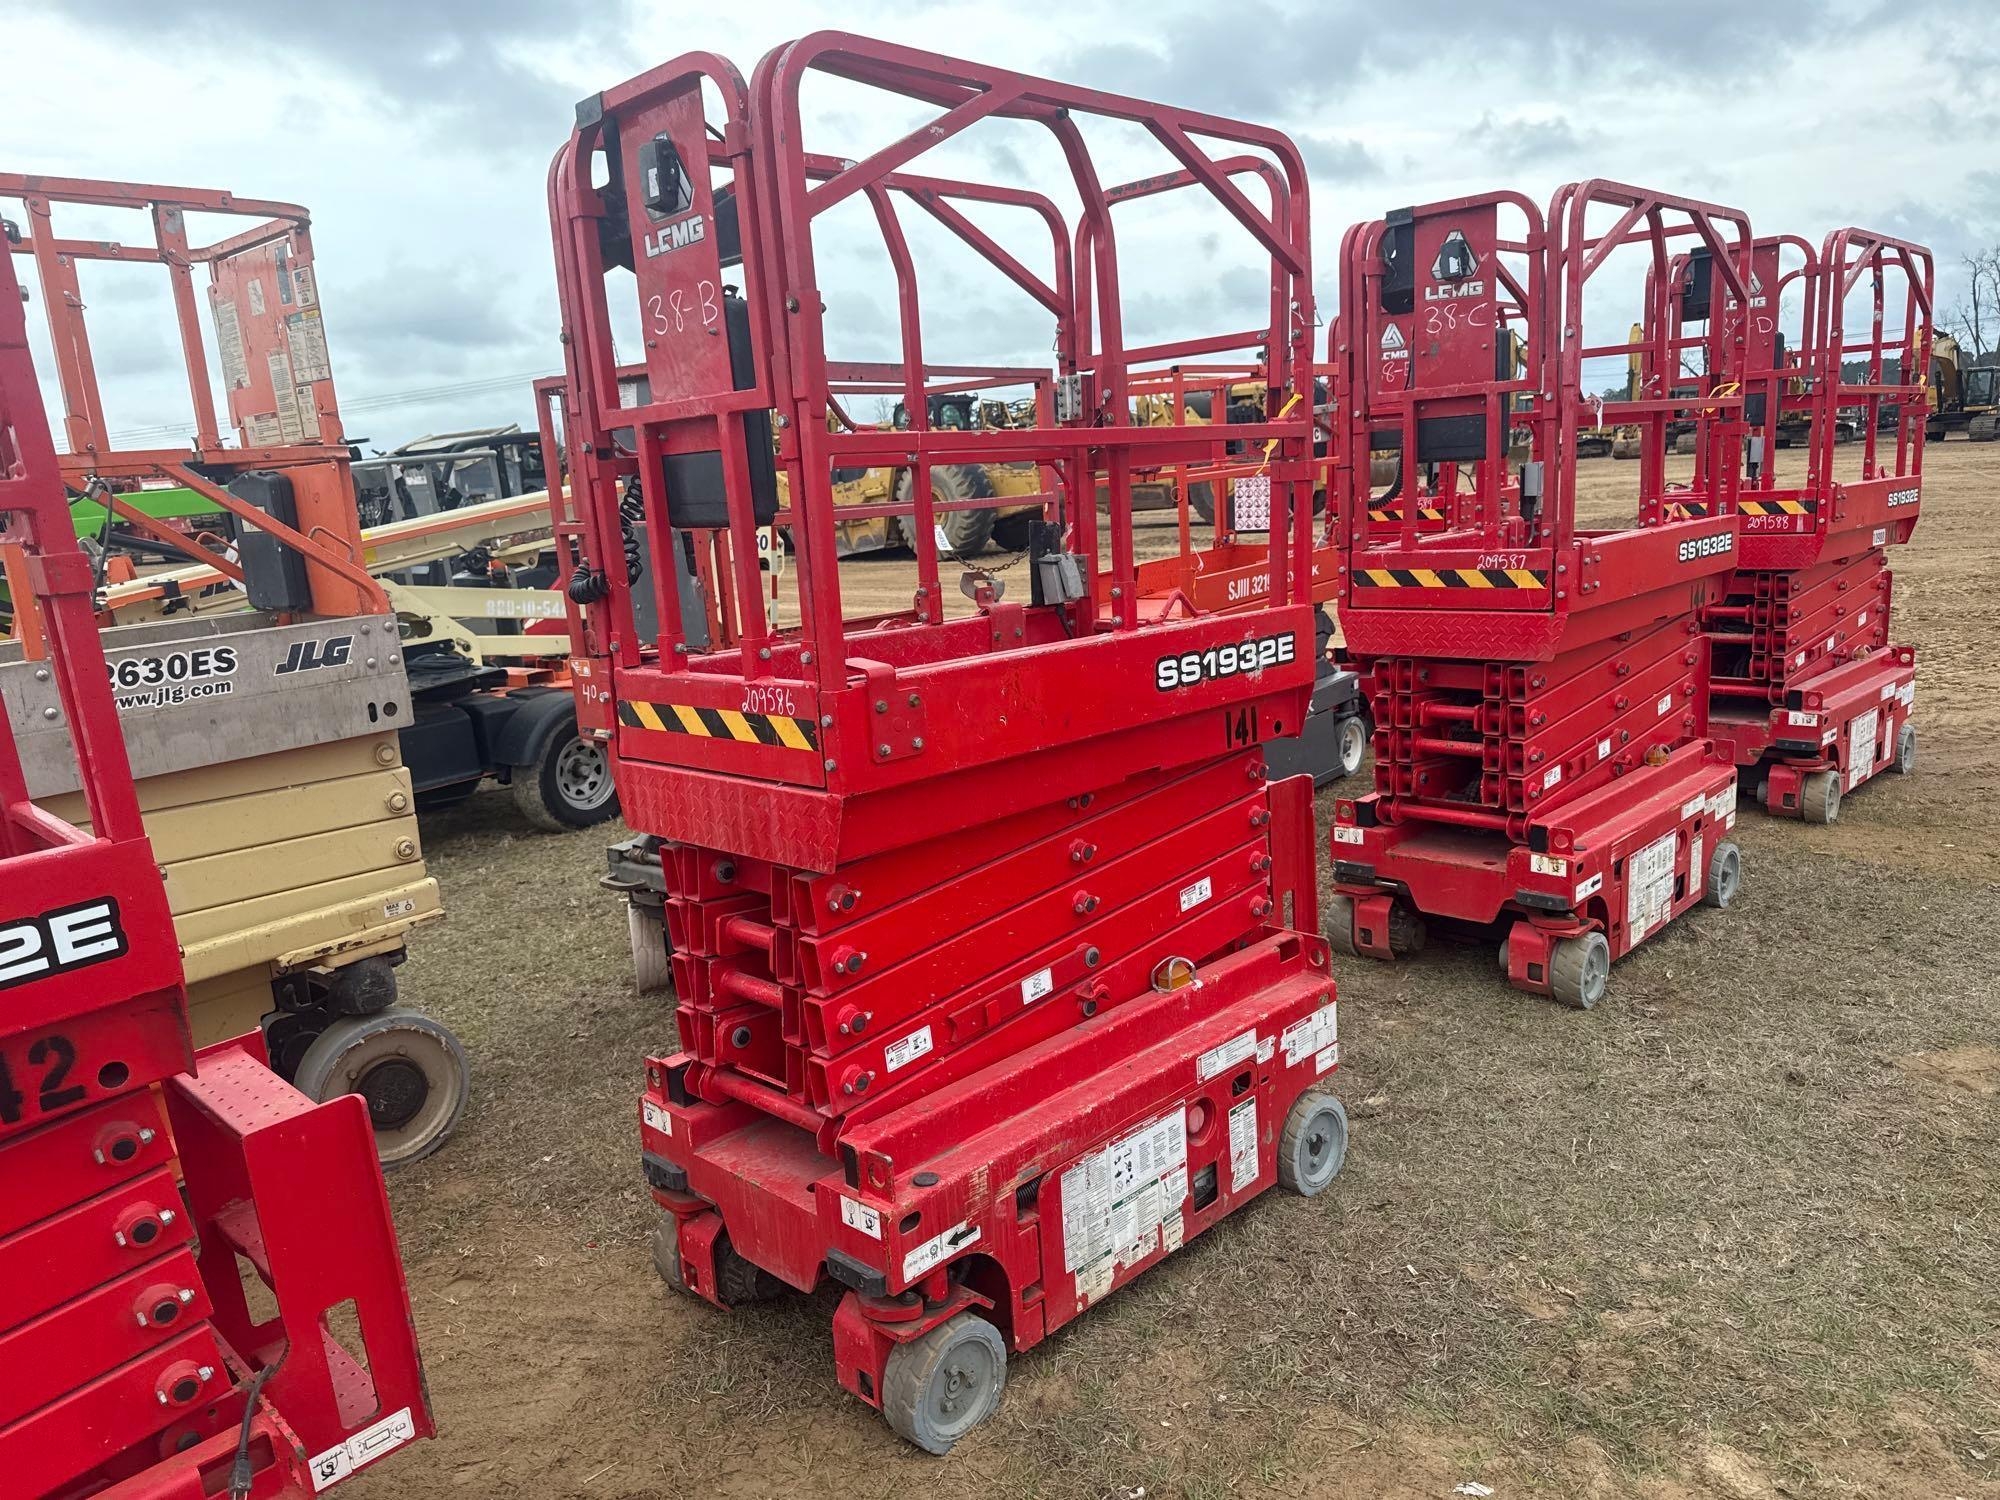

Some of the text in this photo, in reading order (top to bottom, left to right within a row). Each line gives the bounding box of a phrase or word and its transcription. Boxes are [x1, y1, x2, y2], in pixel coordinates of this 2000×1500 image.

[644, 216, 706, 257] LCMG
[1424, 281, 1483, 300] LCMG
[648, 280, 718, 335] 38-B
[1424, 302, 1488, 333] 38-C
[1381, 349, 1408, 360] CMG
[1887, 488, 1919, 507] SS1932E
[1747, 515, 1789, 529] 209588
[1679, 533, 1732, 561] SS1932E
[1476, 554, 1527, 570] 209587
[275, 635, 354, 676] JLG
[1157, 634, 1295, 688] SS1932E
[582, 684, 597, 704] 40
[742, 686, 796, 716] 209586
[1225, 706, 1258, 749] 141
